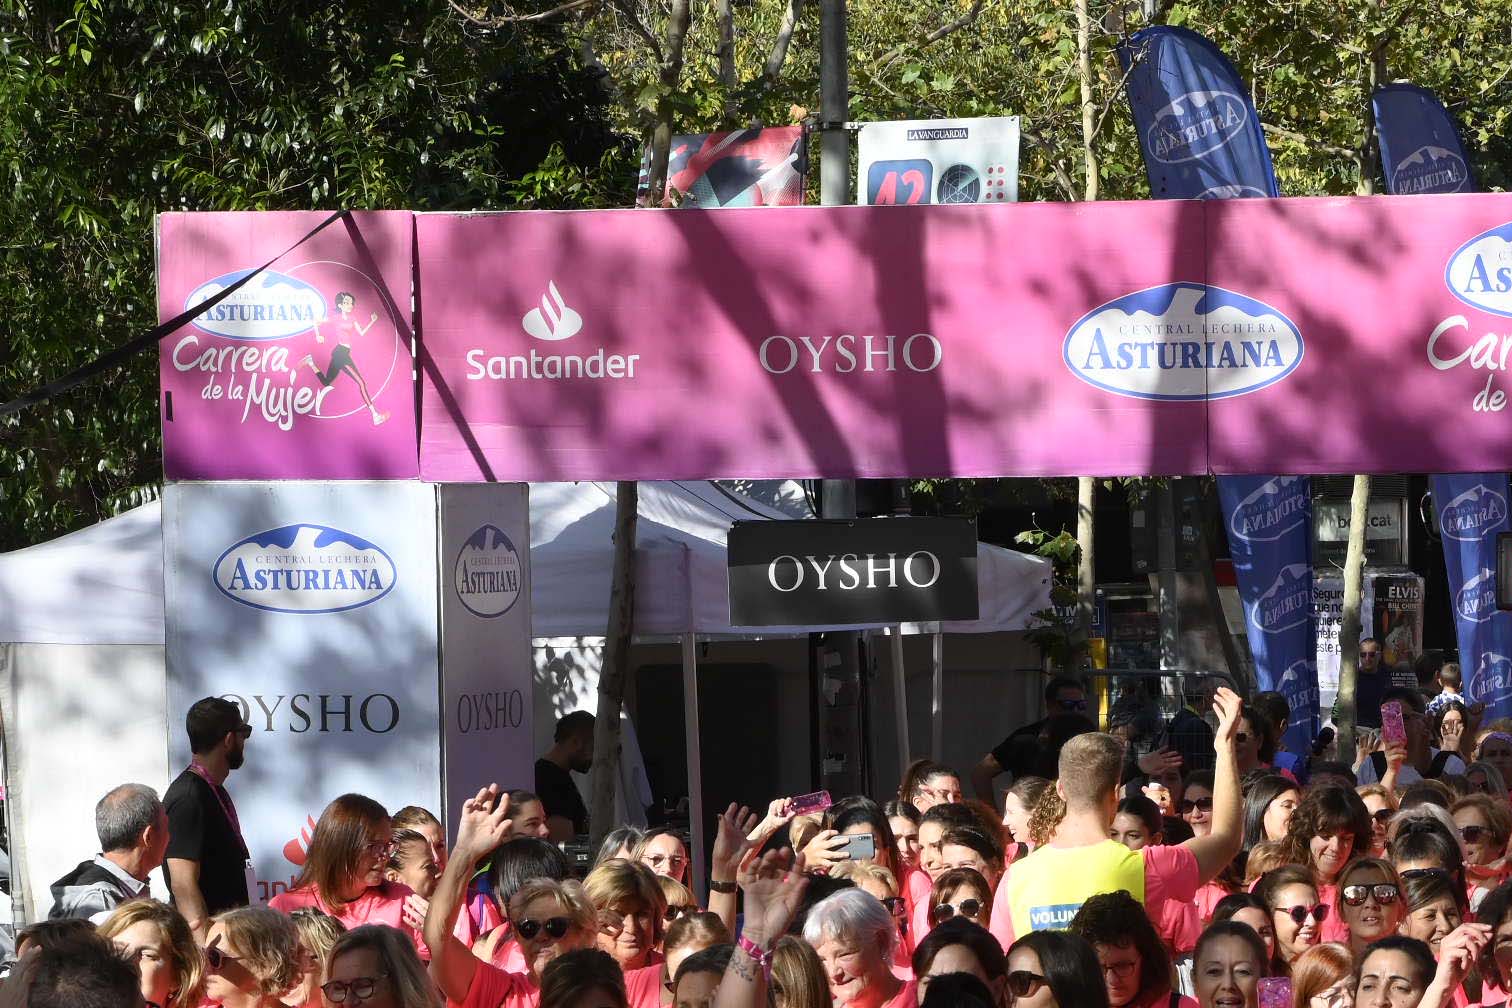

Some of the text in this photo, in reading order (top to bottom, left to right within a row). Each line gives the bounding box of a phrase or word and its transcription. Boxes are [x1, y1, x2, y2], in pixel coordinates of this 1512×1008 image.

[918, 128, 967, 139] VANGUARDIA
[1119, 323, 1276, 335] CENTRAL LECHERA
[173, 335, 289, 373] Carrera
[466, 348, 639, 380] Santander
[759, 333, 942, 374] OYSHO
[1083, 328, 1285, 370] ASTURIANA
[202, 370, 334, 431] de la Mujer
[1473, 375, 1507, 412] de
[227, 557, 384, 591] ASTURIANA
[256, 555, 377, 565] CENTRAL LECHERA
[460, 560, 519, 595] ASTURIANA
[768, 550, 941, 592] OYSHO
[1388, 586, 1419, 599] ELVIS
[458, 690, 523, 733] OYSHO
[1031, 910, 1080, 925] VOLUN
